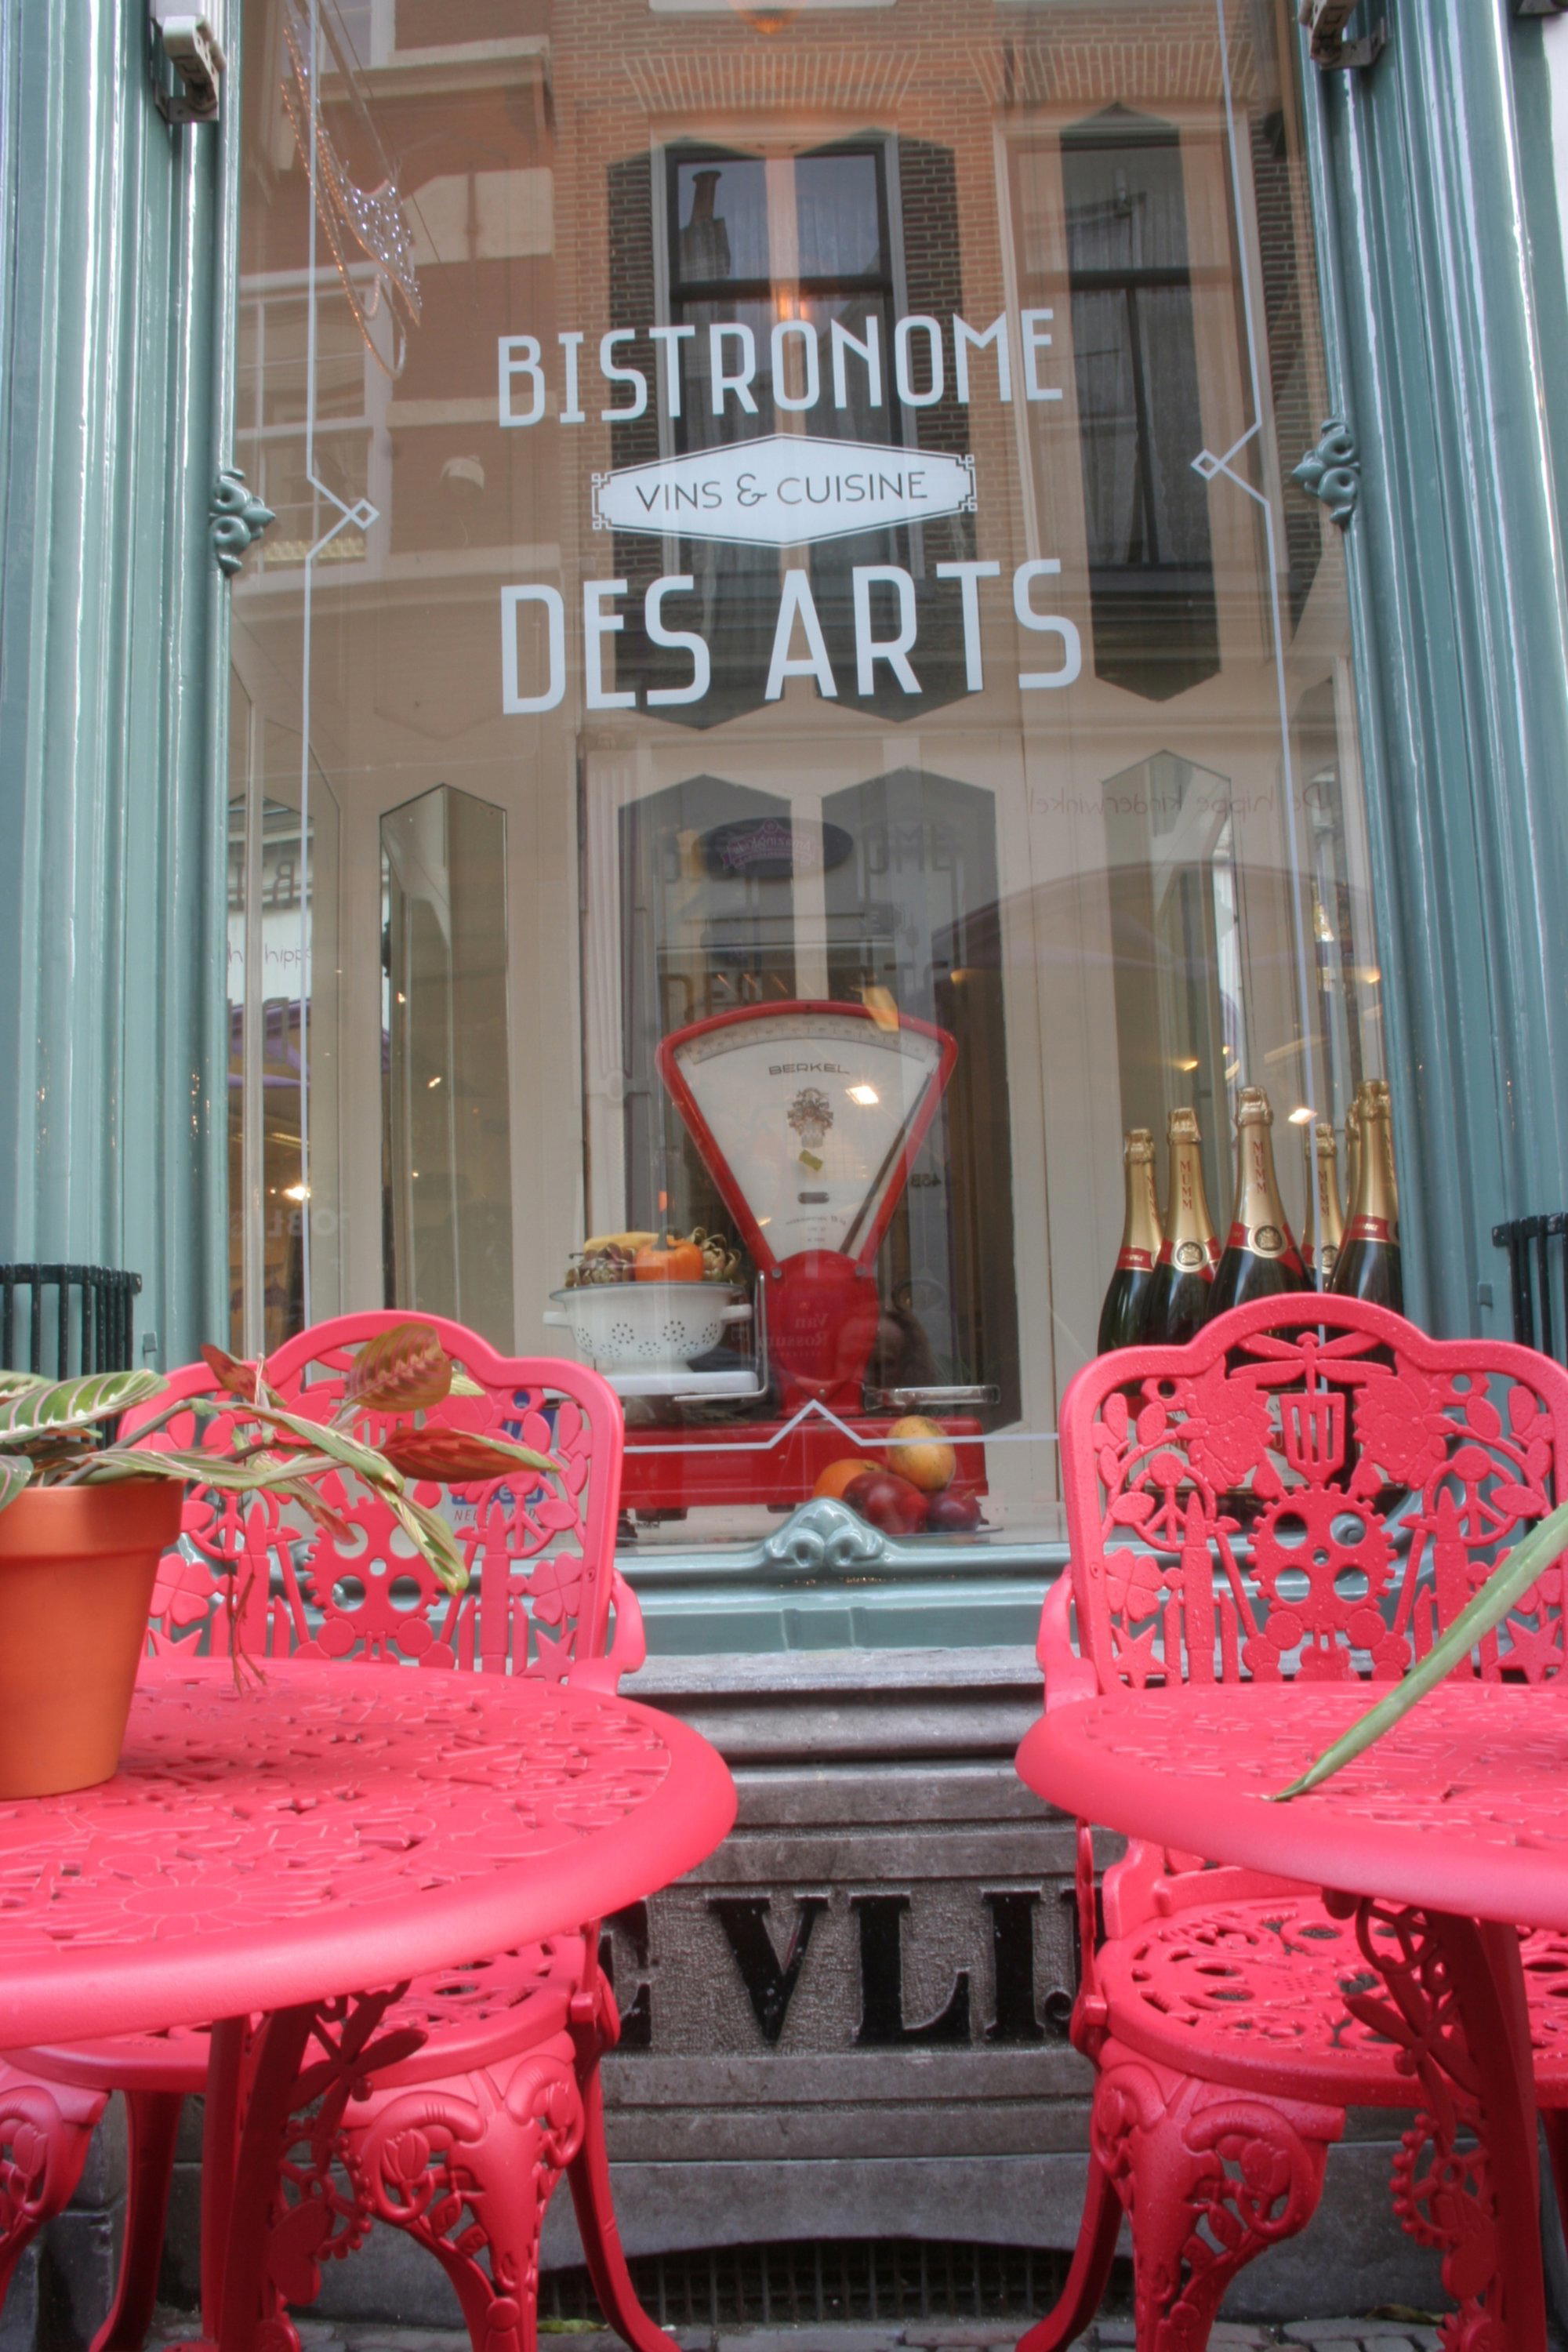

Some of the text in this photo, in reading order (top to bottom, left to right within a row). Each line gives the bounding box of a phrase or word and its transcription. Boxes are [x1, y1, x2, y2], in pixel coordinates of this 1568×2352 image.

[499, 308, 1063, 427] BISTRONOME
[636, 471, 927, 512] VINS & CUISINE
[500, 558, 1082, 714] DES ARTS
[768, 1062, 850, 1076] BERKEL
[1180, 1160, 1192, 1210] MUMM
[1254, 1140, 1267, 1194] MUMM
